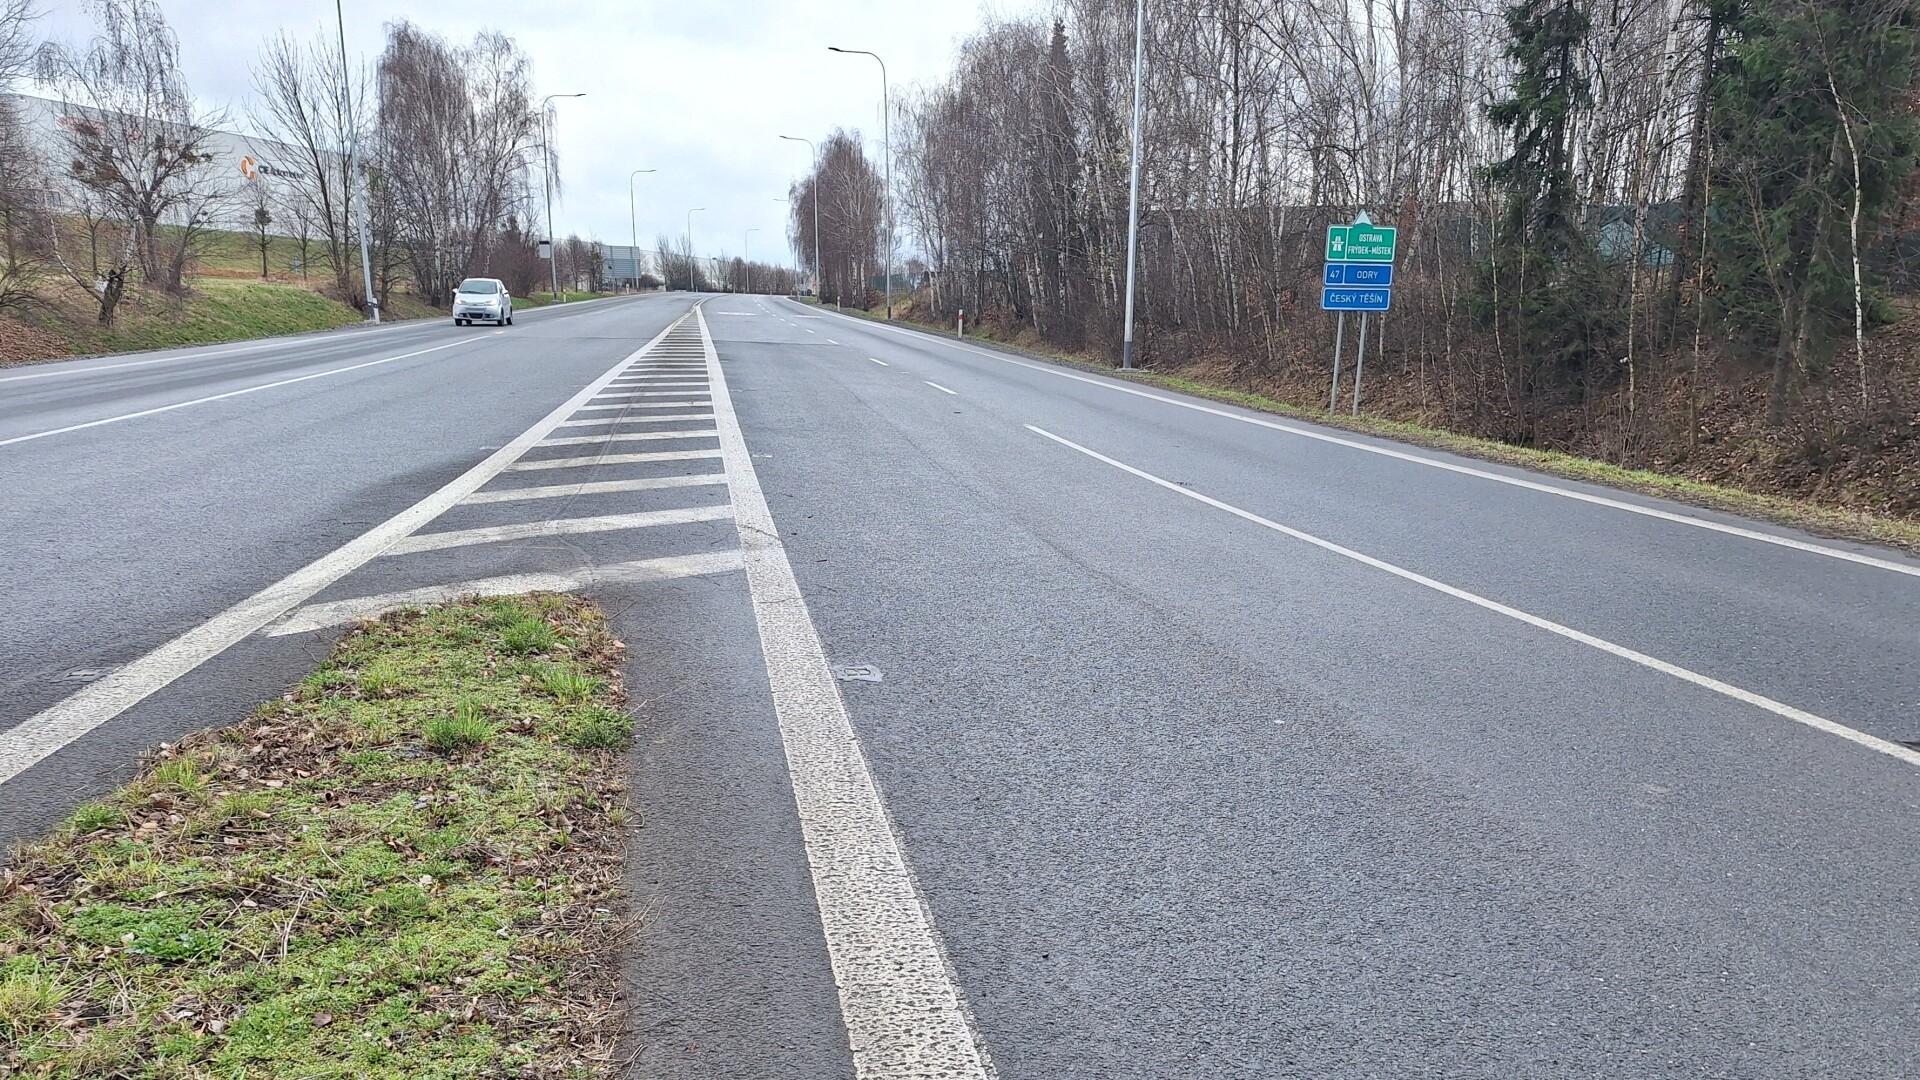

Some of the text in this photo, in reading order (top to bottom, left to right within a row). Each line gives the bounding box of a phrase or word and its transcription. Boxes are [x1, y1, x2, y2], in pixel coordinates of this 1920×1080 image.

[1359, 233, 1383, 243] OSTRAVA
[1348, 244, 1392, 255] FRÝDEK-MÍSTEK
[1329, 270, 1378, 279] 47 ODRY
[1329, 293, 1383, 303] ČESKÝ TĚŠÍN
